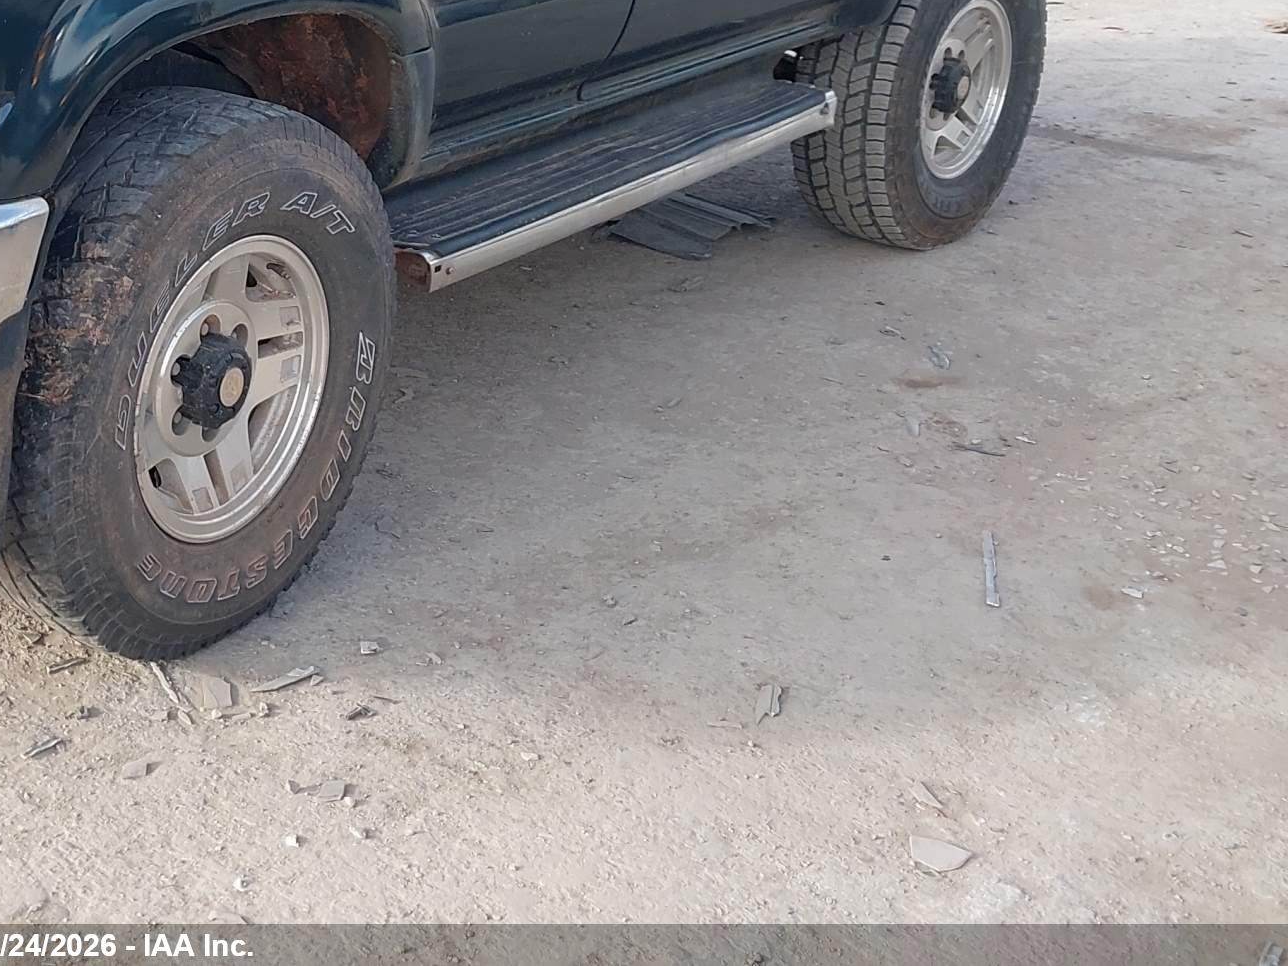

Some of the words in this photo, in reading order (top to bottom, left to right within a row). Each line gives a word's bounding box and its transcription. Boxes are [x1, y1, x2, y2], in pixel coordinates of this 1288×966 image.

[114, 191, 271, 451] DUELER
[280, 190, 357, 236] A/T
[136, 330, 377, 605] BRIDGESTONE
